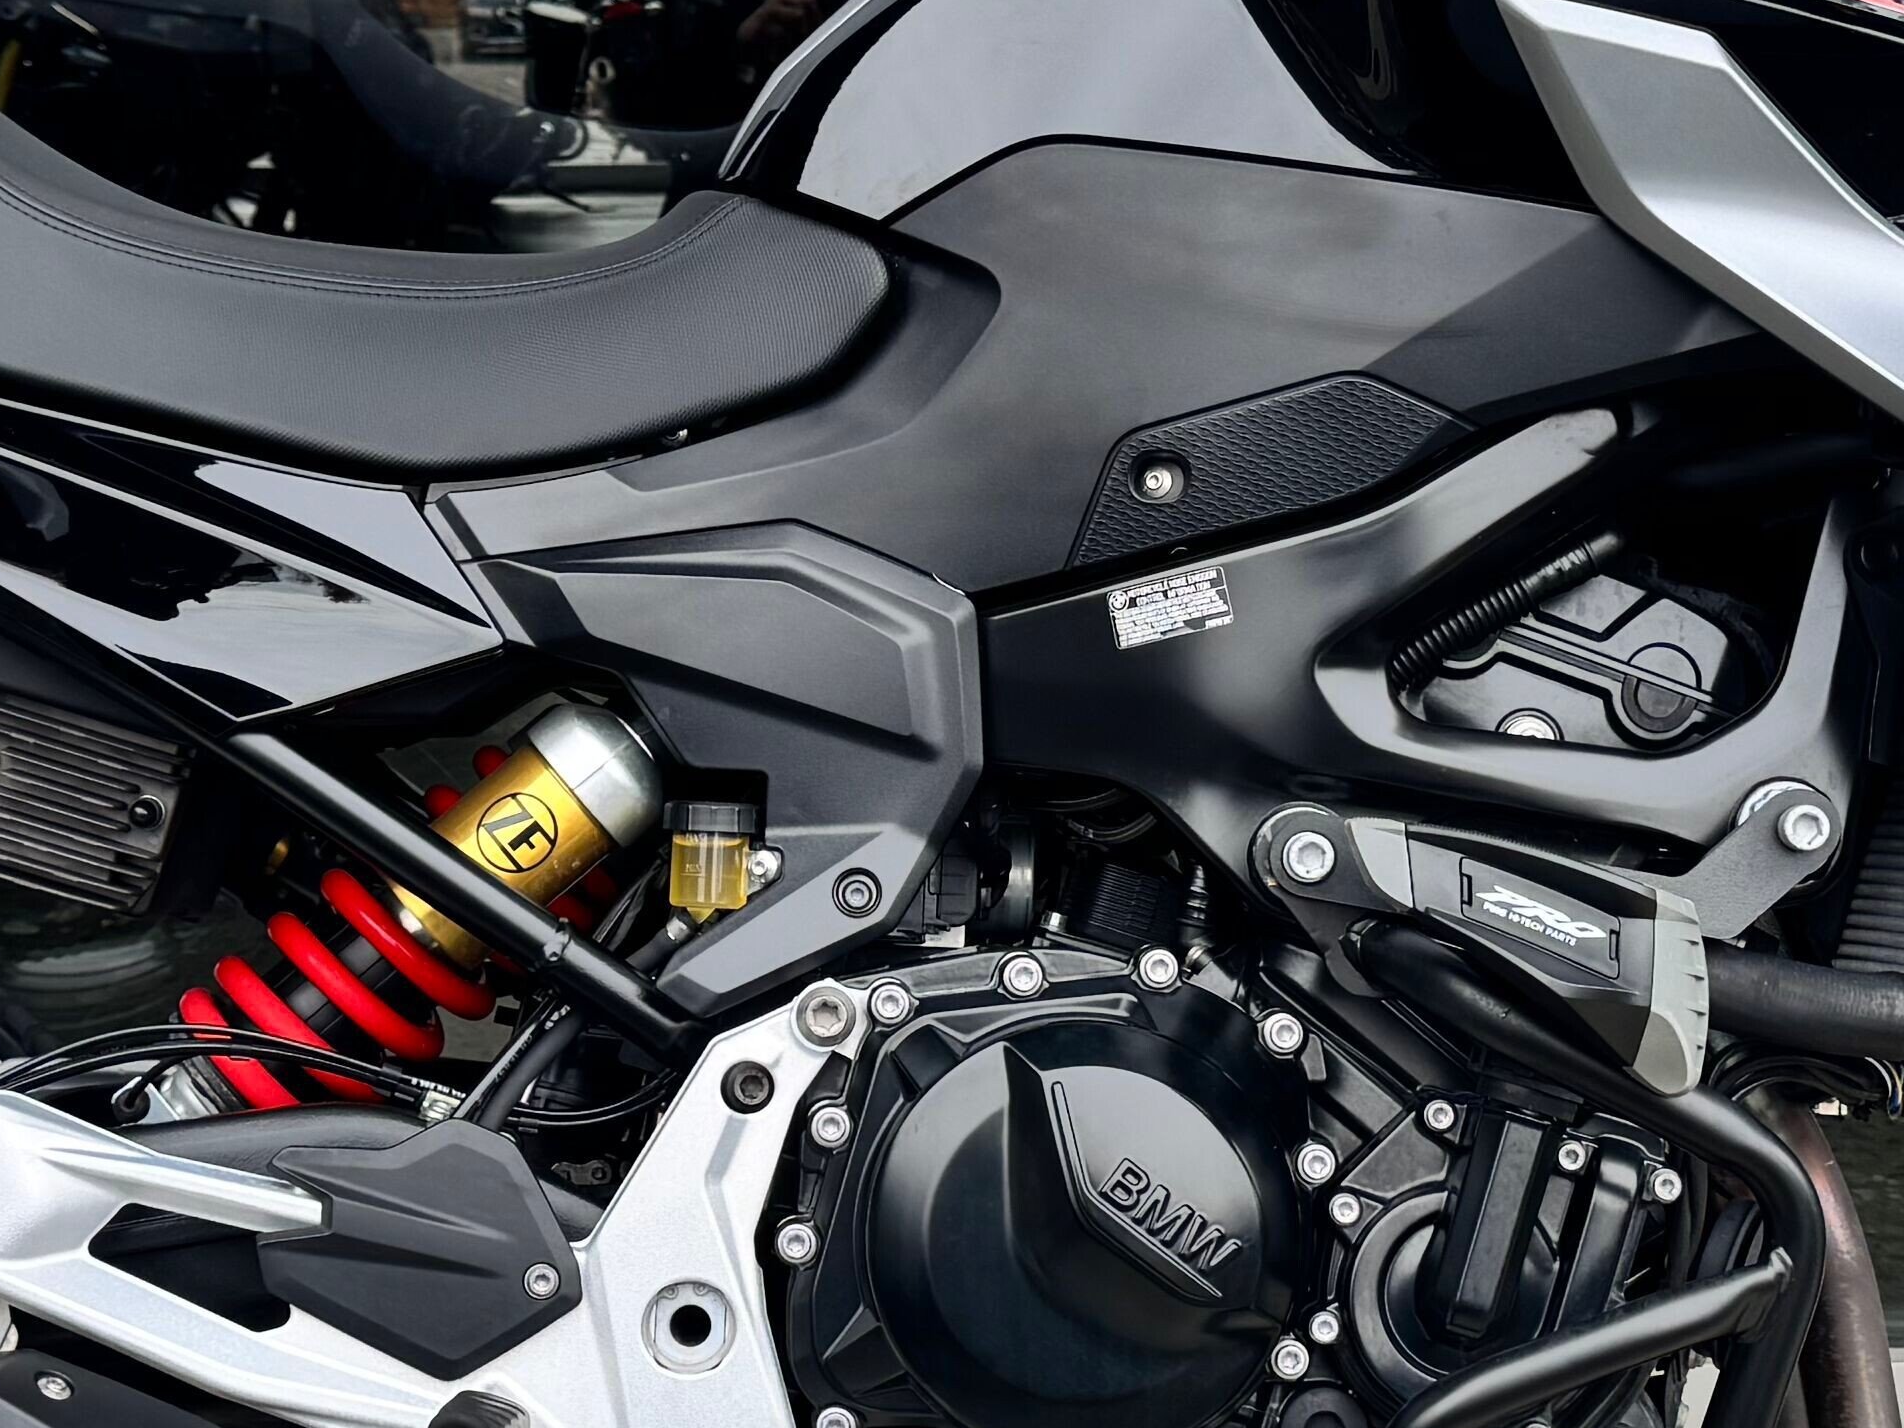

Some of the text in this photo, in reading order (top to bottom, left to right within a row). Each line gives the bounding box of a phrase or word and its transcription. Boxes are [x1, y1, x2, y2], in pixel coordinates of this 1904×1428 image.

[479, 794, 556, 872] ZF
[1475, 884, 1609, 938] PRO
[1545, 926, 1578, 948] PARTS
[1098, 1157, 1242, 1272] BMW
